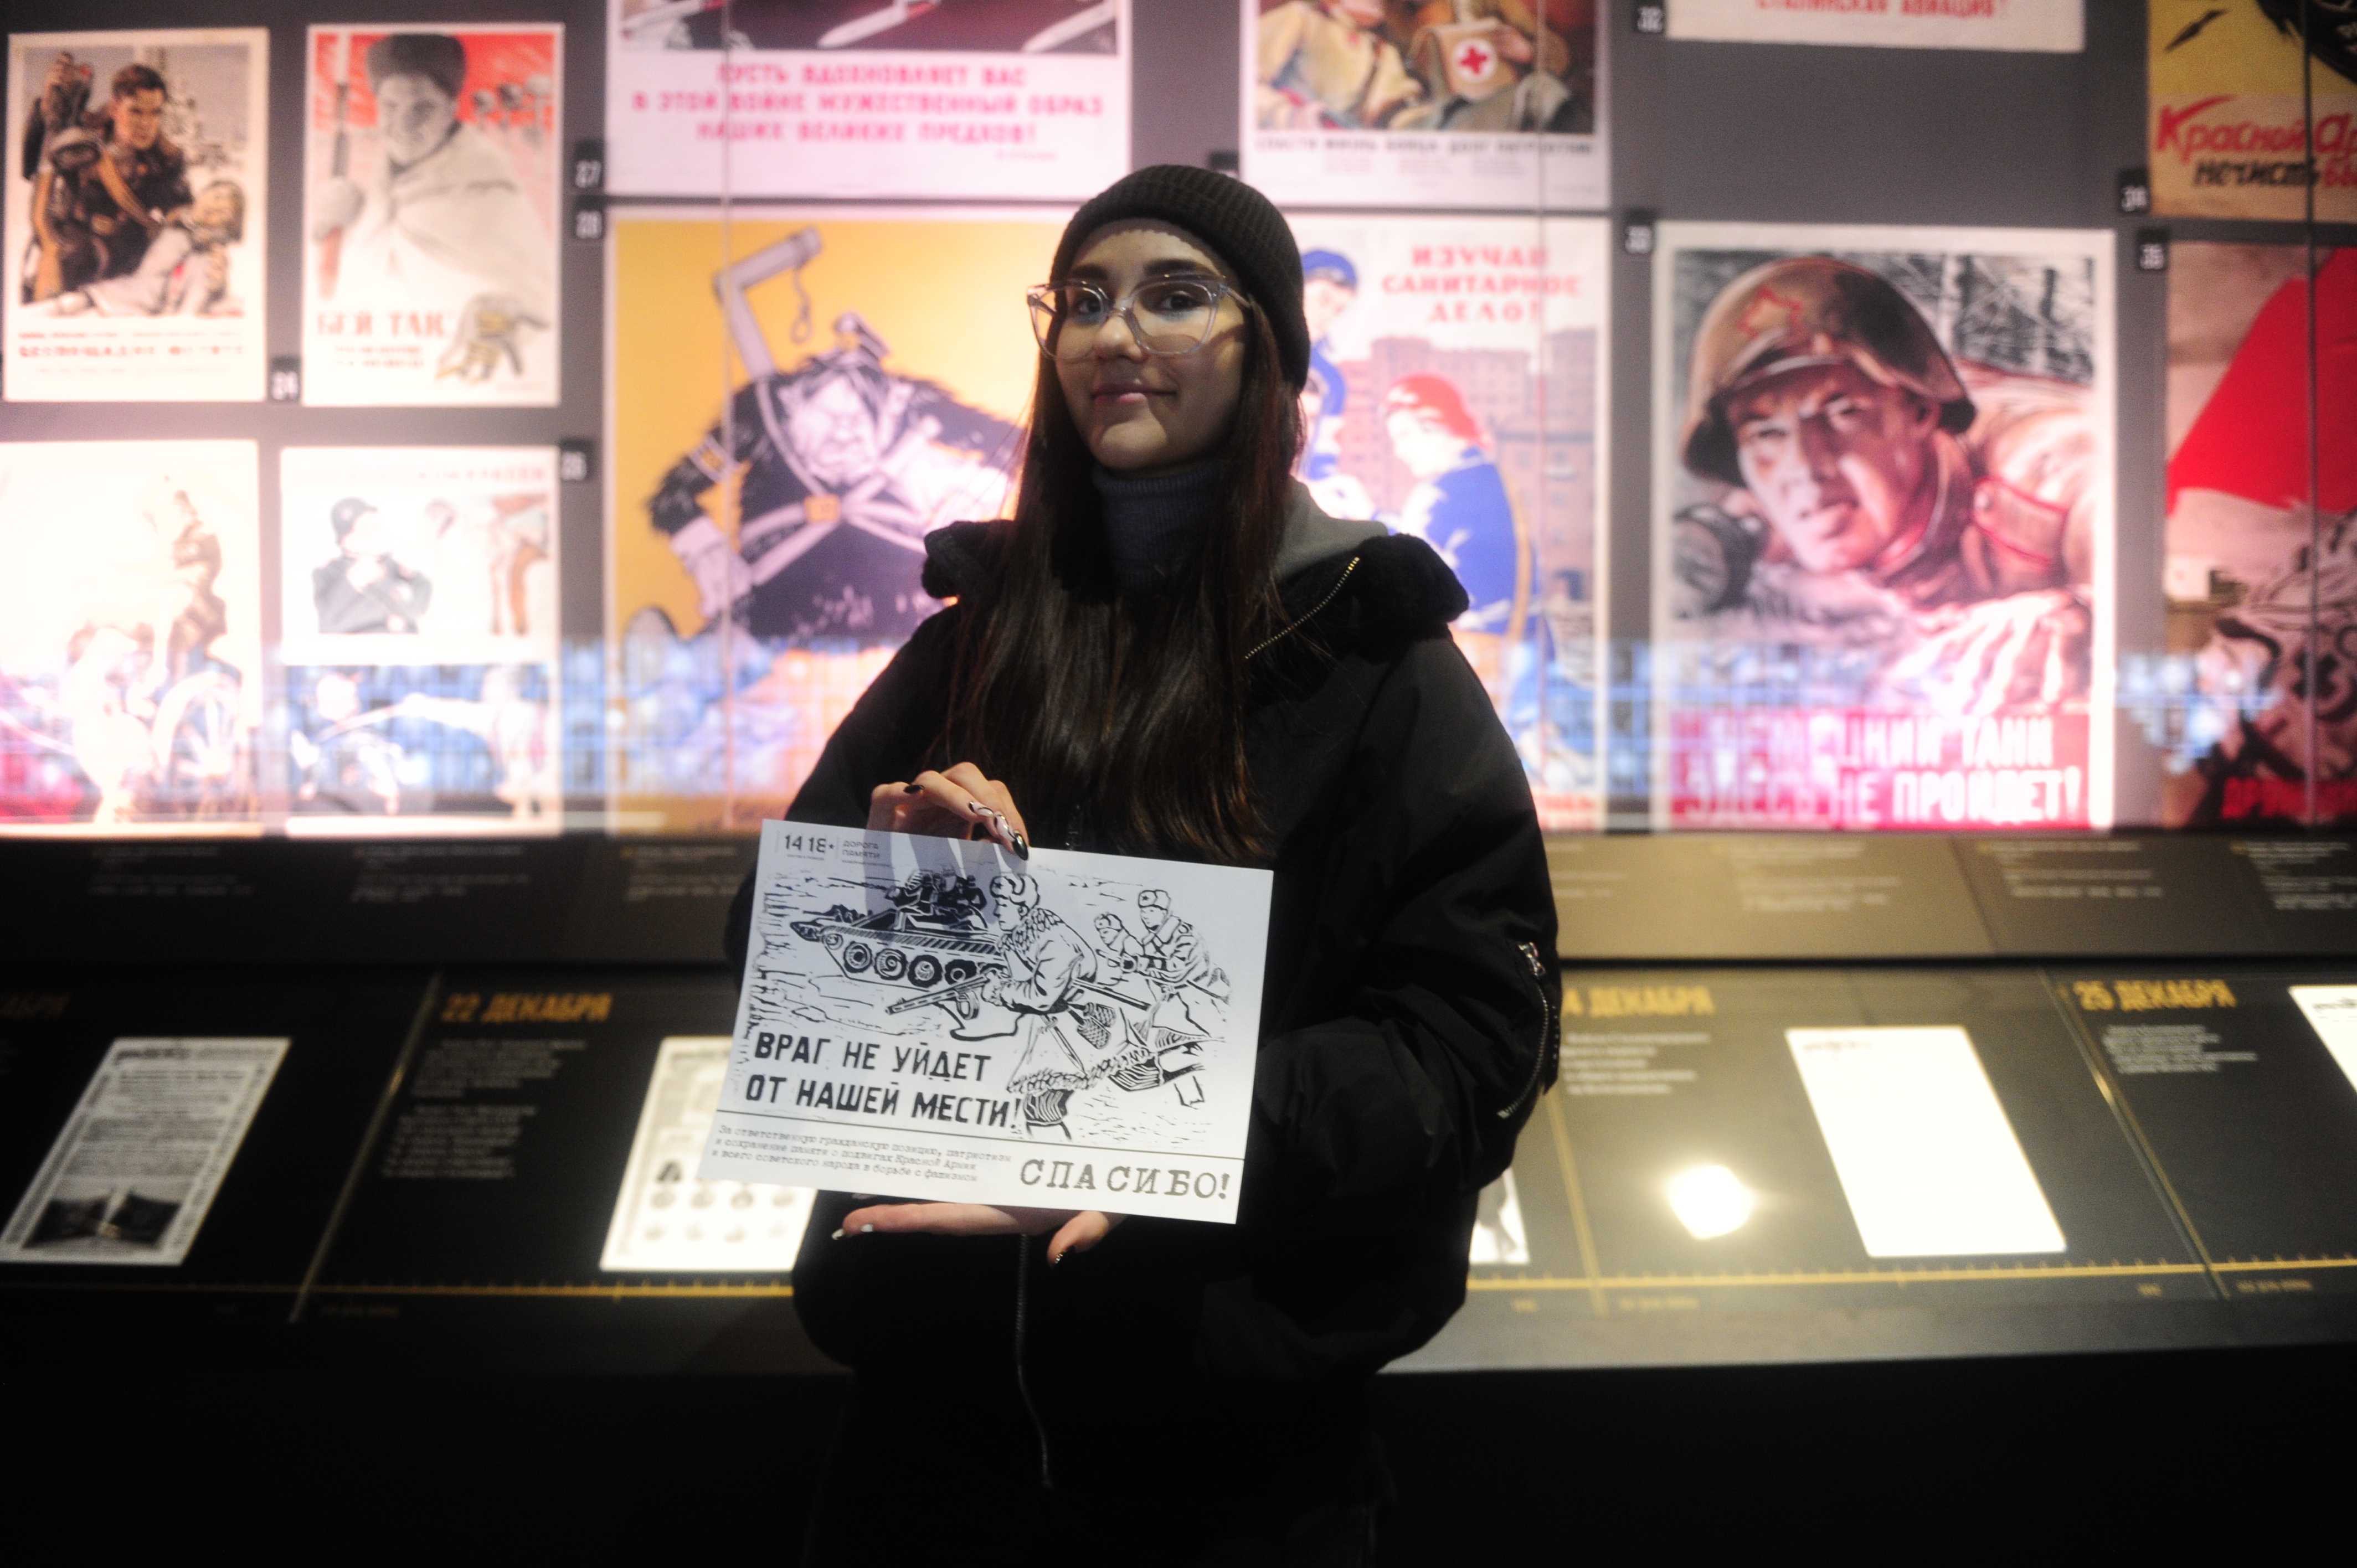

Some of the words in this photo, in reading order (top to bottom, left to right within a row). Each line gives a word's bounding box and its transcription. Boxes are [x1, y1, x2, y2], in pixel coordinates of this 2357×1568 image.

[982, 66, 1026, 87] ВАС
[842, 840, 879, 849] ДОРОГА
[842, 849, 881, 859] ПАМЯТИ
[481, 992, 612, 1024] ДЕКАБРЯ
[1588, 986, 1715, 1018] ДЕКАБРЯ
[2114, 979, 2237, 1012] ДЕКАБРЯ
[754, 1031, 831, 1064] ВРАГ
[842, 1041, 881, 1070] НЕ
[892, 1041, 992, 1082] УЙДЕТ
[745, 1074, 787, 1103] ОТ
[796, 1081, 900, 1116] НАШЕЙ
[911, 1091, 1022, 1132] МЕСТИ!
[719, 1125, 732, 1134] За
[734, 1128, 817, 1144] ответственную
[819, 1137, 889, 1151] гражданскую
[892, 1144, 941, 1157] позицию,
[946, 1149, 1012, 1163] патриотизм
[725, 1139, 787, 1152] сохранение
[790, 1146, 828, 1156] памяти
[841, 1151, 893, 1163] подвигах
[894, 1154, 941, 1166] Красной
[943, 1160, 977, 1170] Армии
[722, 1151, 753, 1160] всего
[755, 1154, 820, 1167] советского
[821, 1160, 861, 1170] народа
[872, 1164, 912, 1176] борьбе
[924, 1169, 978, 1183] фашизмом
[1020, 1158, 1231, 1200] СПАСИБО!
